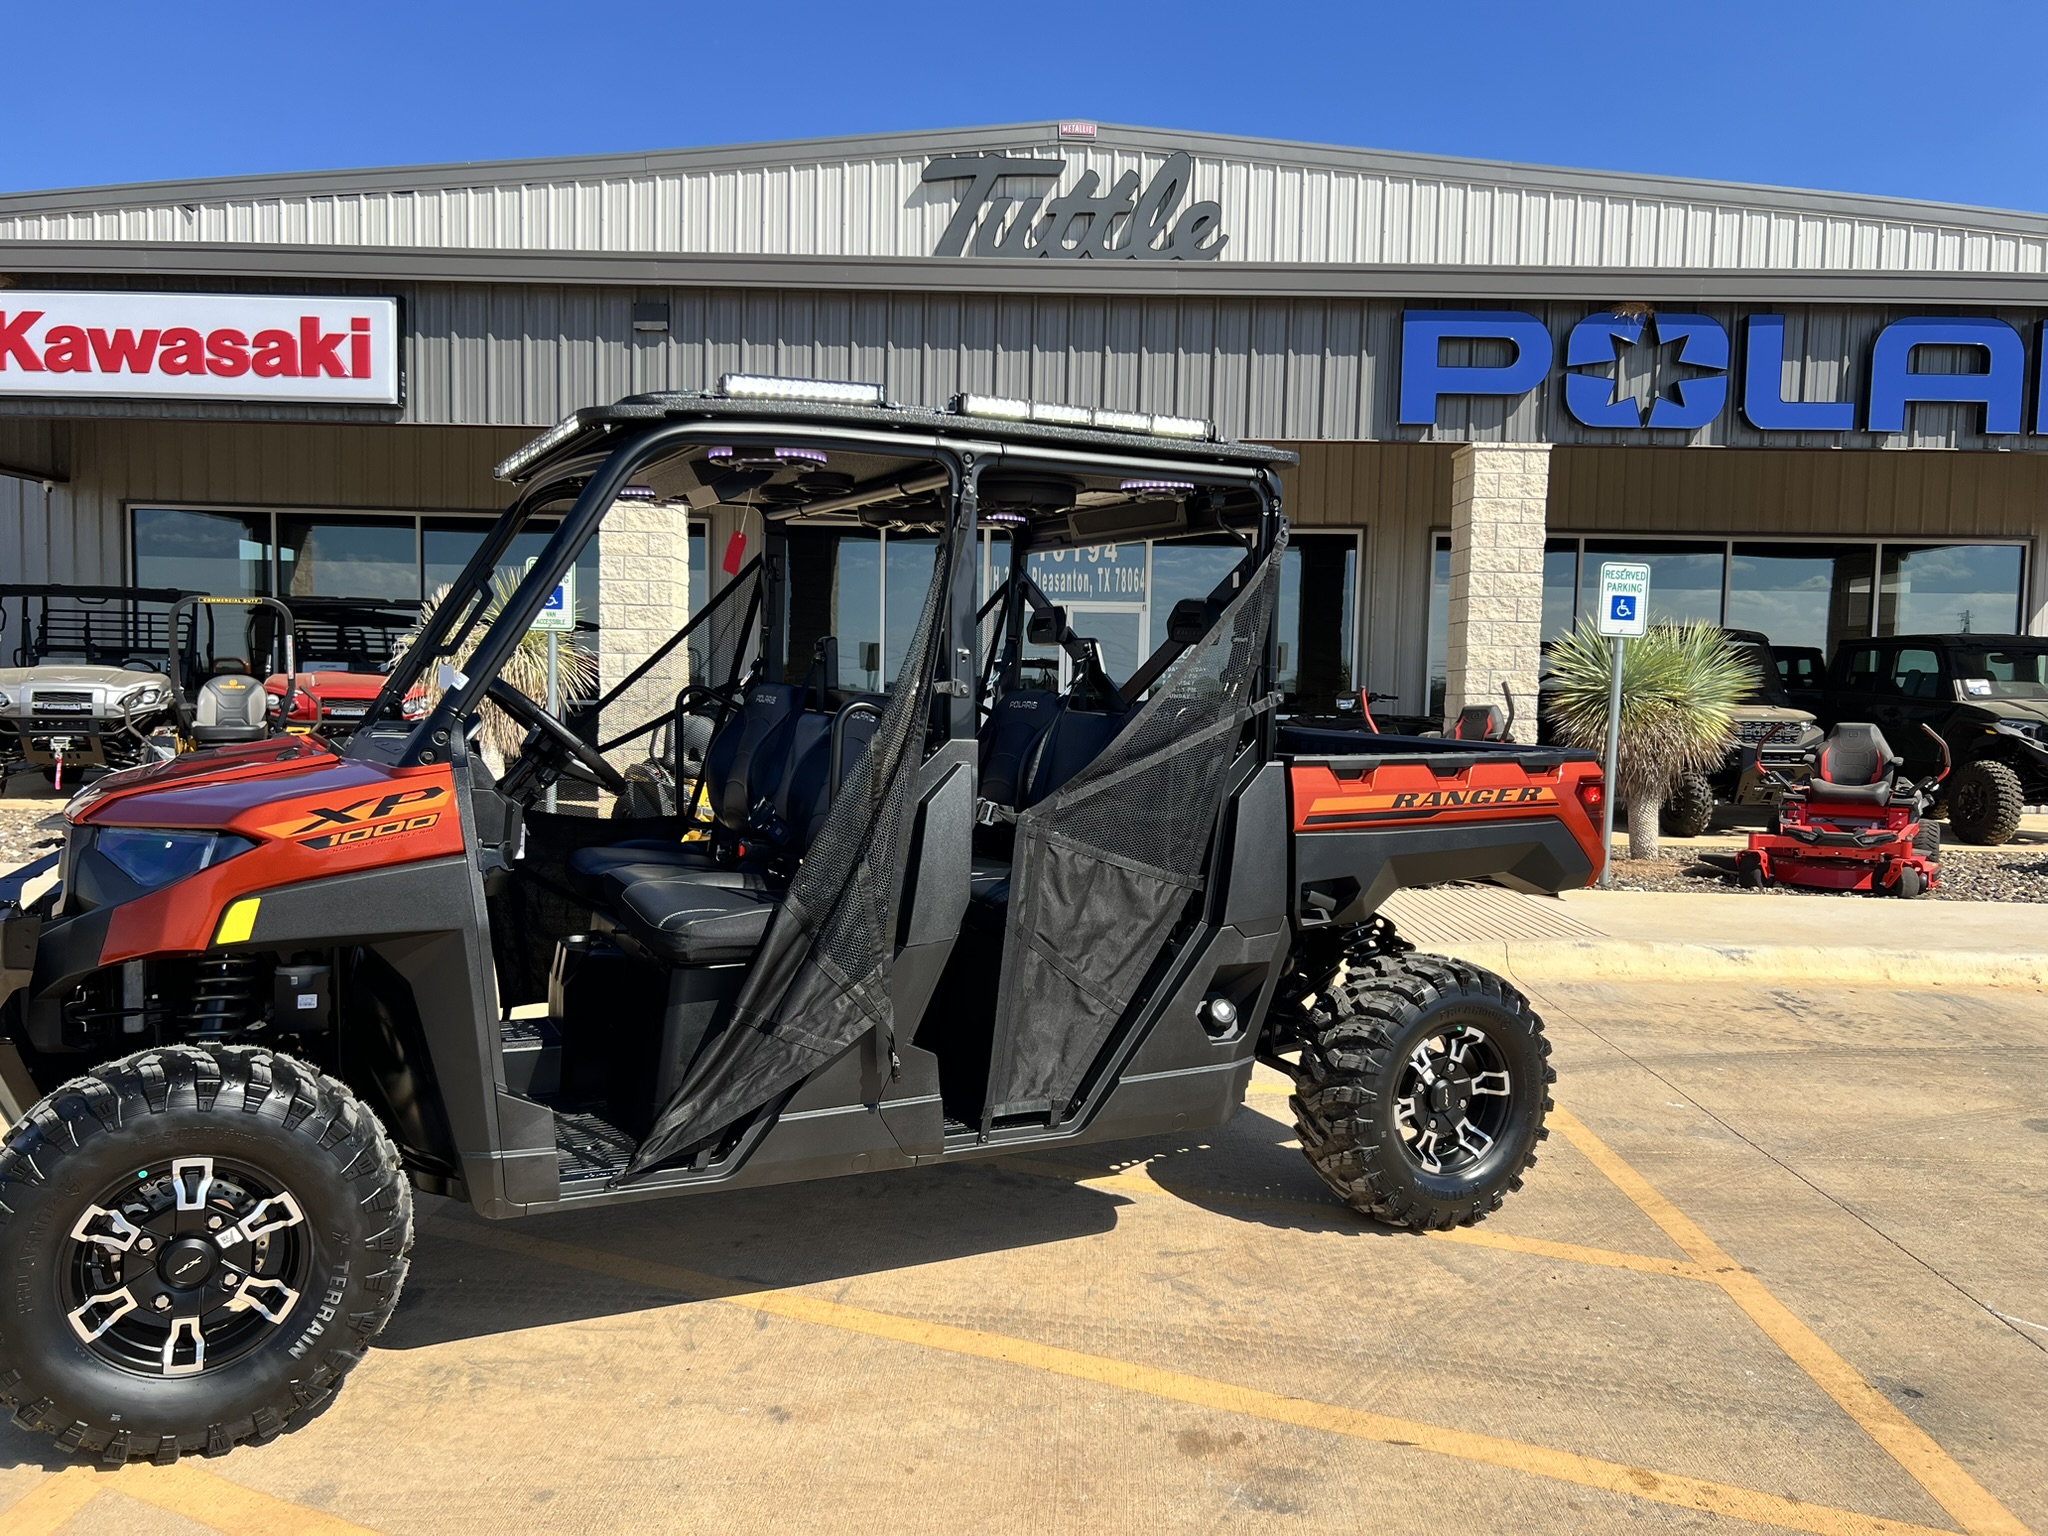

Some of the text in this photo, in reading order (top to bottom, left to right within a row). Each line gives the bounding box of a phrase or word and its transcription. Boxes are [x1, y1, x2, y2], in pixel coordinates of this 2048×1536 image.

[922, 152, 1229, 260] Tuttle
[0, 310, 372, 379] Kawasaki
[1399, 309, 2048, 437] POLA
[1098, 567, 1111, 592] TX
[1115, 566, 1145, 592] 78064
[1605, 569, 1646, 581] RESERVED
[1606, 582, 1643, 593] PARKING
[1009, 700, 1038, 710] POLARIS
[288, 786, 445, 836] XP
[1391, 786, 1543, 808] RANGER
[329, 814, 439, 847] 1000
